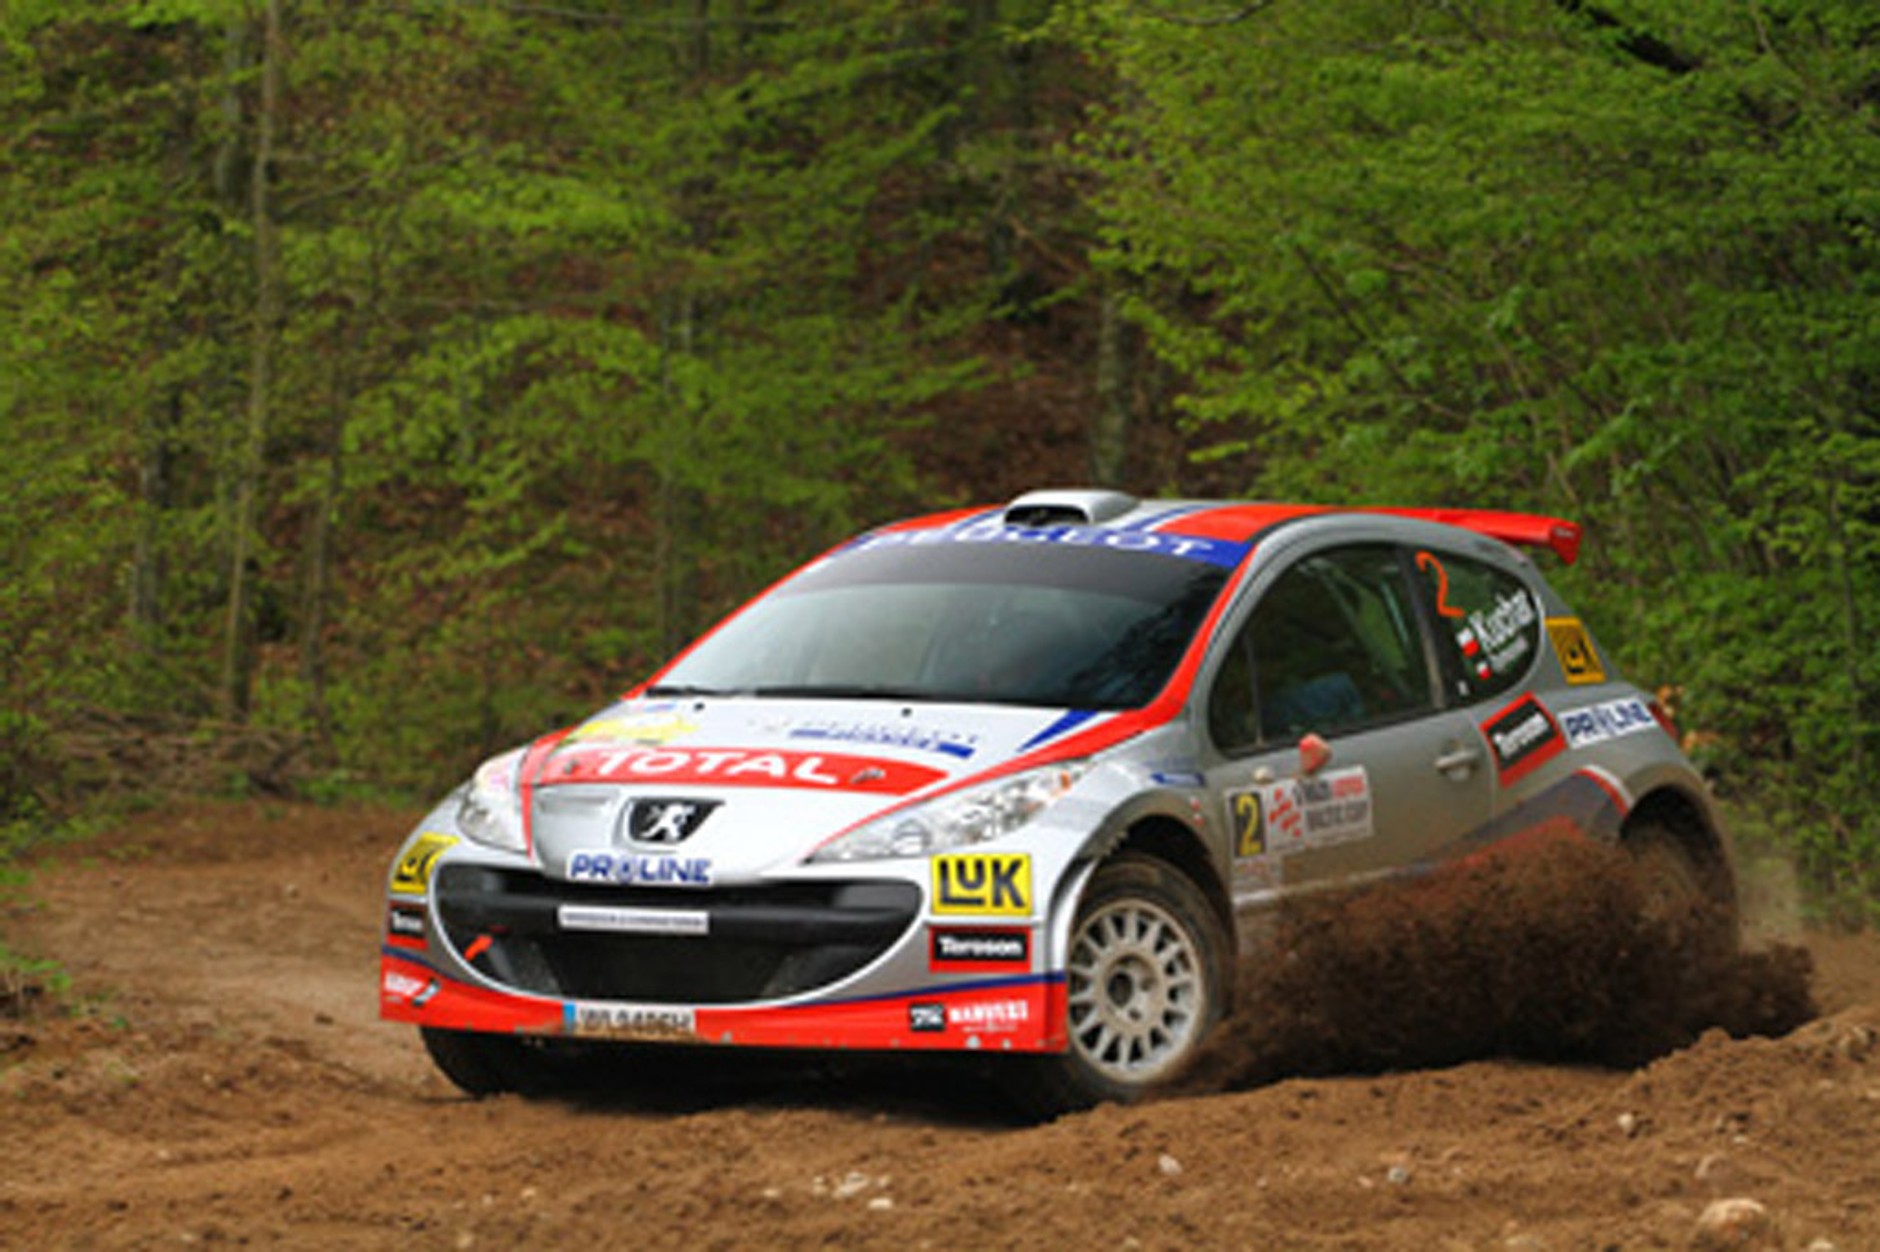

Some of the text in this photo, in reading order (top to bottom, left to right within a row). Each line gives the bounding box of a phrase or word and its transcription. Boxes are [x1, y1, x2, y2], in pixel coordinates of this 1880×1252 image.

[1415, 551, 1466, 618] 2
[599, 751, 838, 785] TOTAL
[1236, 793, 1262, 857] 2
